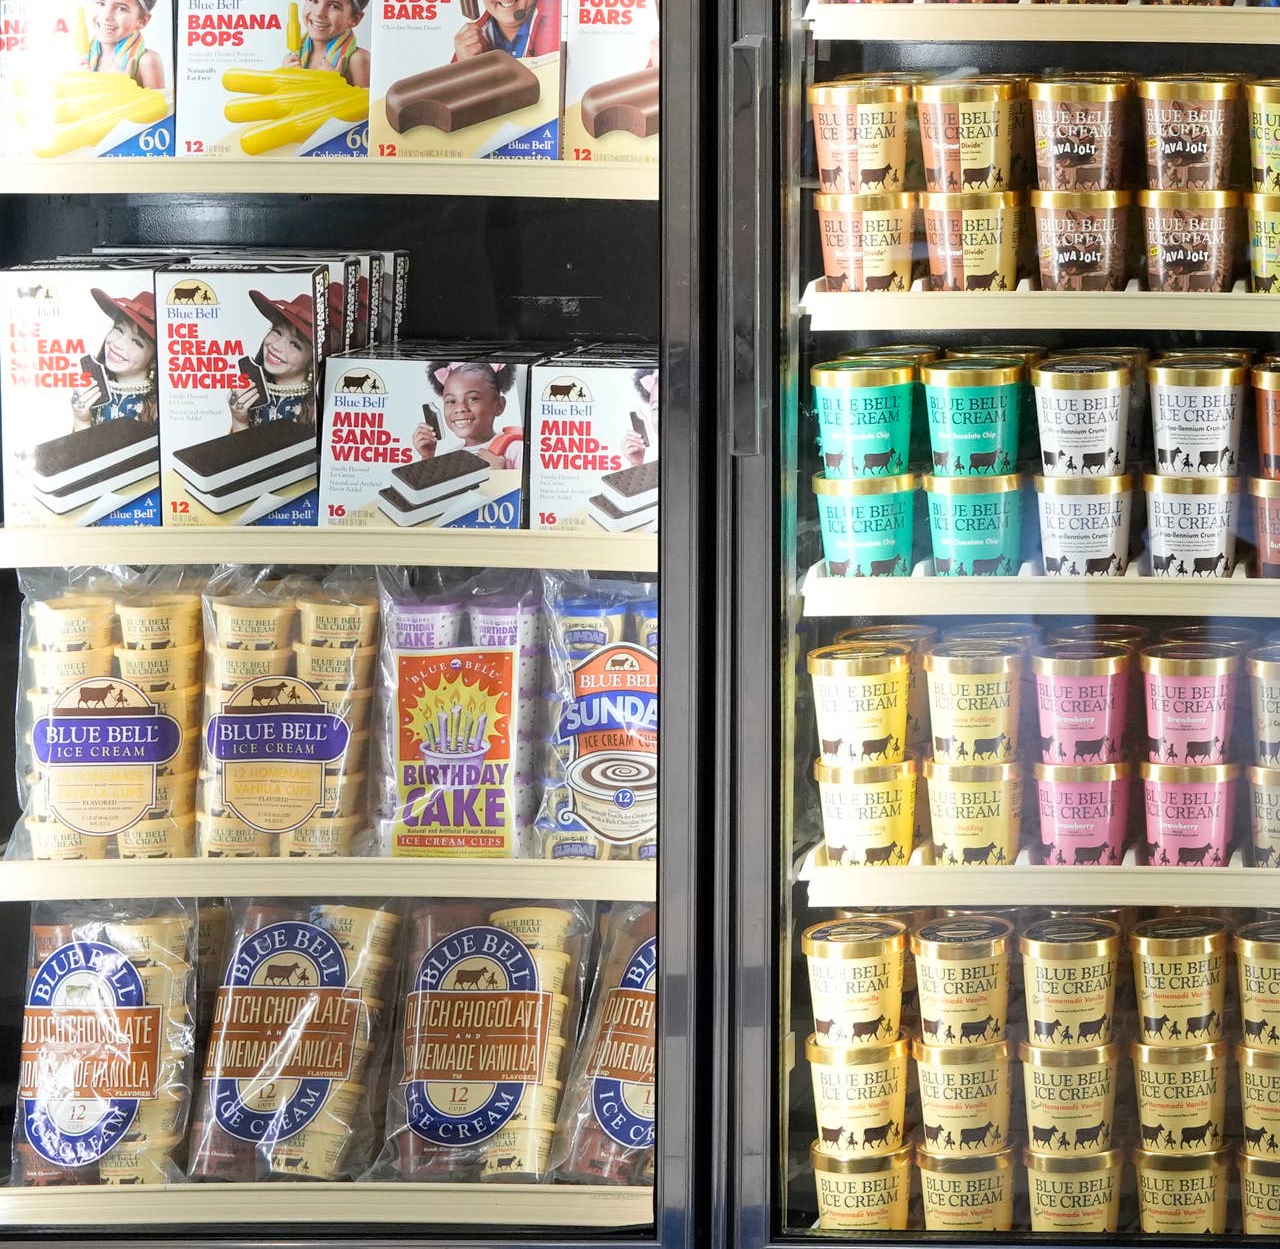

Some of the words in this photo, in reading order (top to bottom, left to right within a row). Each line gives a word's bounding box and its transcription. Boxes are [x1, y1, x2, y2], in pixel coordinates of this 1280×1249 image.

[383, 4, 437, 20] BARS
[188, 14, 281, 30] BANANA
[188, 31, 244, 47] POPS
[139, 128, 170, 150] 60
[185, 141, 204, 153] 12
[1160, 140, 1182, 154] JAVA
[1185, 141, 1207, 154] JOLT
[379, 145, 396, 157] 12
[167, 307, 193, 319] Blue
[195, 307, 219, 319] Bell
[168, 323, 198, 339] ICE
[168, 340, 244, 356] CREAM
[169, 357, 236, 372] SAND-
[170, 373, 250, 390] WICHES
[334, 396, 361, 407] Blue
[362, 396, 385, 408] Bell
[332, 412, 384, 429] MINI
[331, 429, 400, 446] SAND-
[331, 446, 413, 463] WICHES
[171, 502, 189, 513] 12
[328, 504, 346, 517] 16
[475, 502, 514, 523] 100
[410, 662, 446, 684] BLUE
[466, 660, 496, 679] BELL
[220, 723, 268, 741] BLUE
[278, 722, 328, 741] BELL
[232, 743, 257, 754] ICE
[266, 742, 315, 754] CREAM
[403, 763, 509, 785] BIRTHDAY
[617, 792, 631, 803] 12
[403, 788, 505, 827] CAKE
[402, 837, 422, 846] ICE
[426, 837, 467, 846] CREAM
[472, 837, 501, 846] CUPS
[421, 935, 476, 985] BLUE
[483, 933, 530, 985] BELL
[1143, 962, 1182, 975] BLUE
[1187, 957, 1221, 974] BELL
[1145, 976, 1166, 989] ICE
[1169, 971, 1220, 989] CREAM
[452, 1000, 544, 1030] CHOCOLATE
[479, 1043, 537, 1072] VANILLA
[449, 1087, 469, 1103] 12
